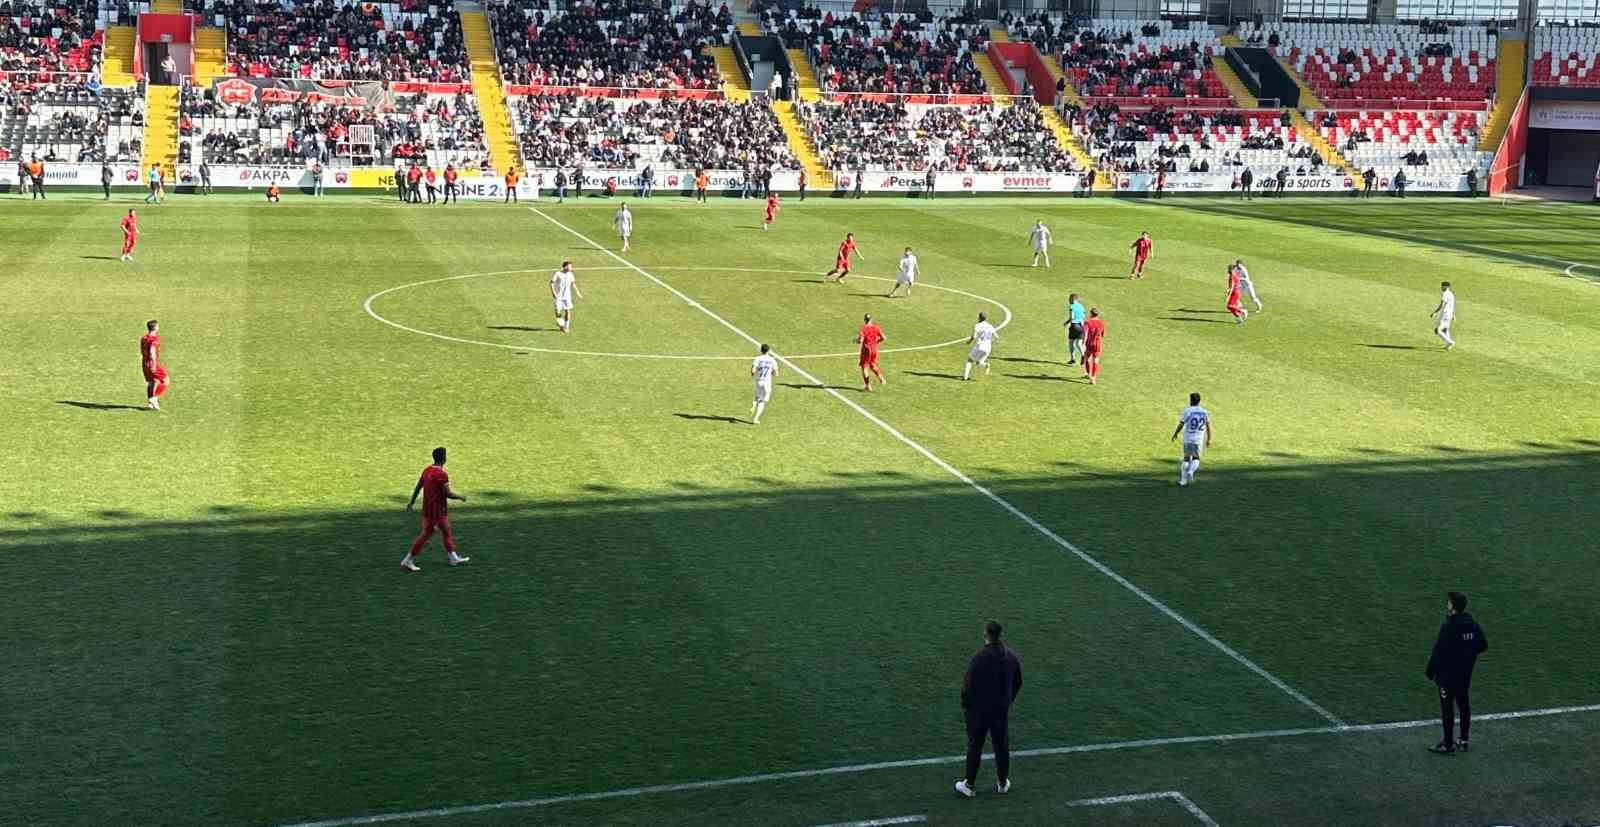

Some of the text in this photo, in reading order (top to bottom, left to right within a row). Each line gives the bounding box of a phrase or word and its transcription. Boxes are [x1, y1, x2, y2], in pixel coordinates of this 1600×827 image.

[252, 170, 290, 181] AKPA
[889, 175, 928, 188] Persa
[1003, 176, 1052, 187] evmer
[1296, 176, 1332, 189] sports
[1190, 417, 1206, 431] 92
